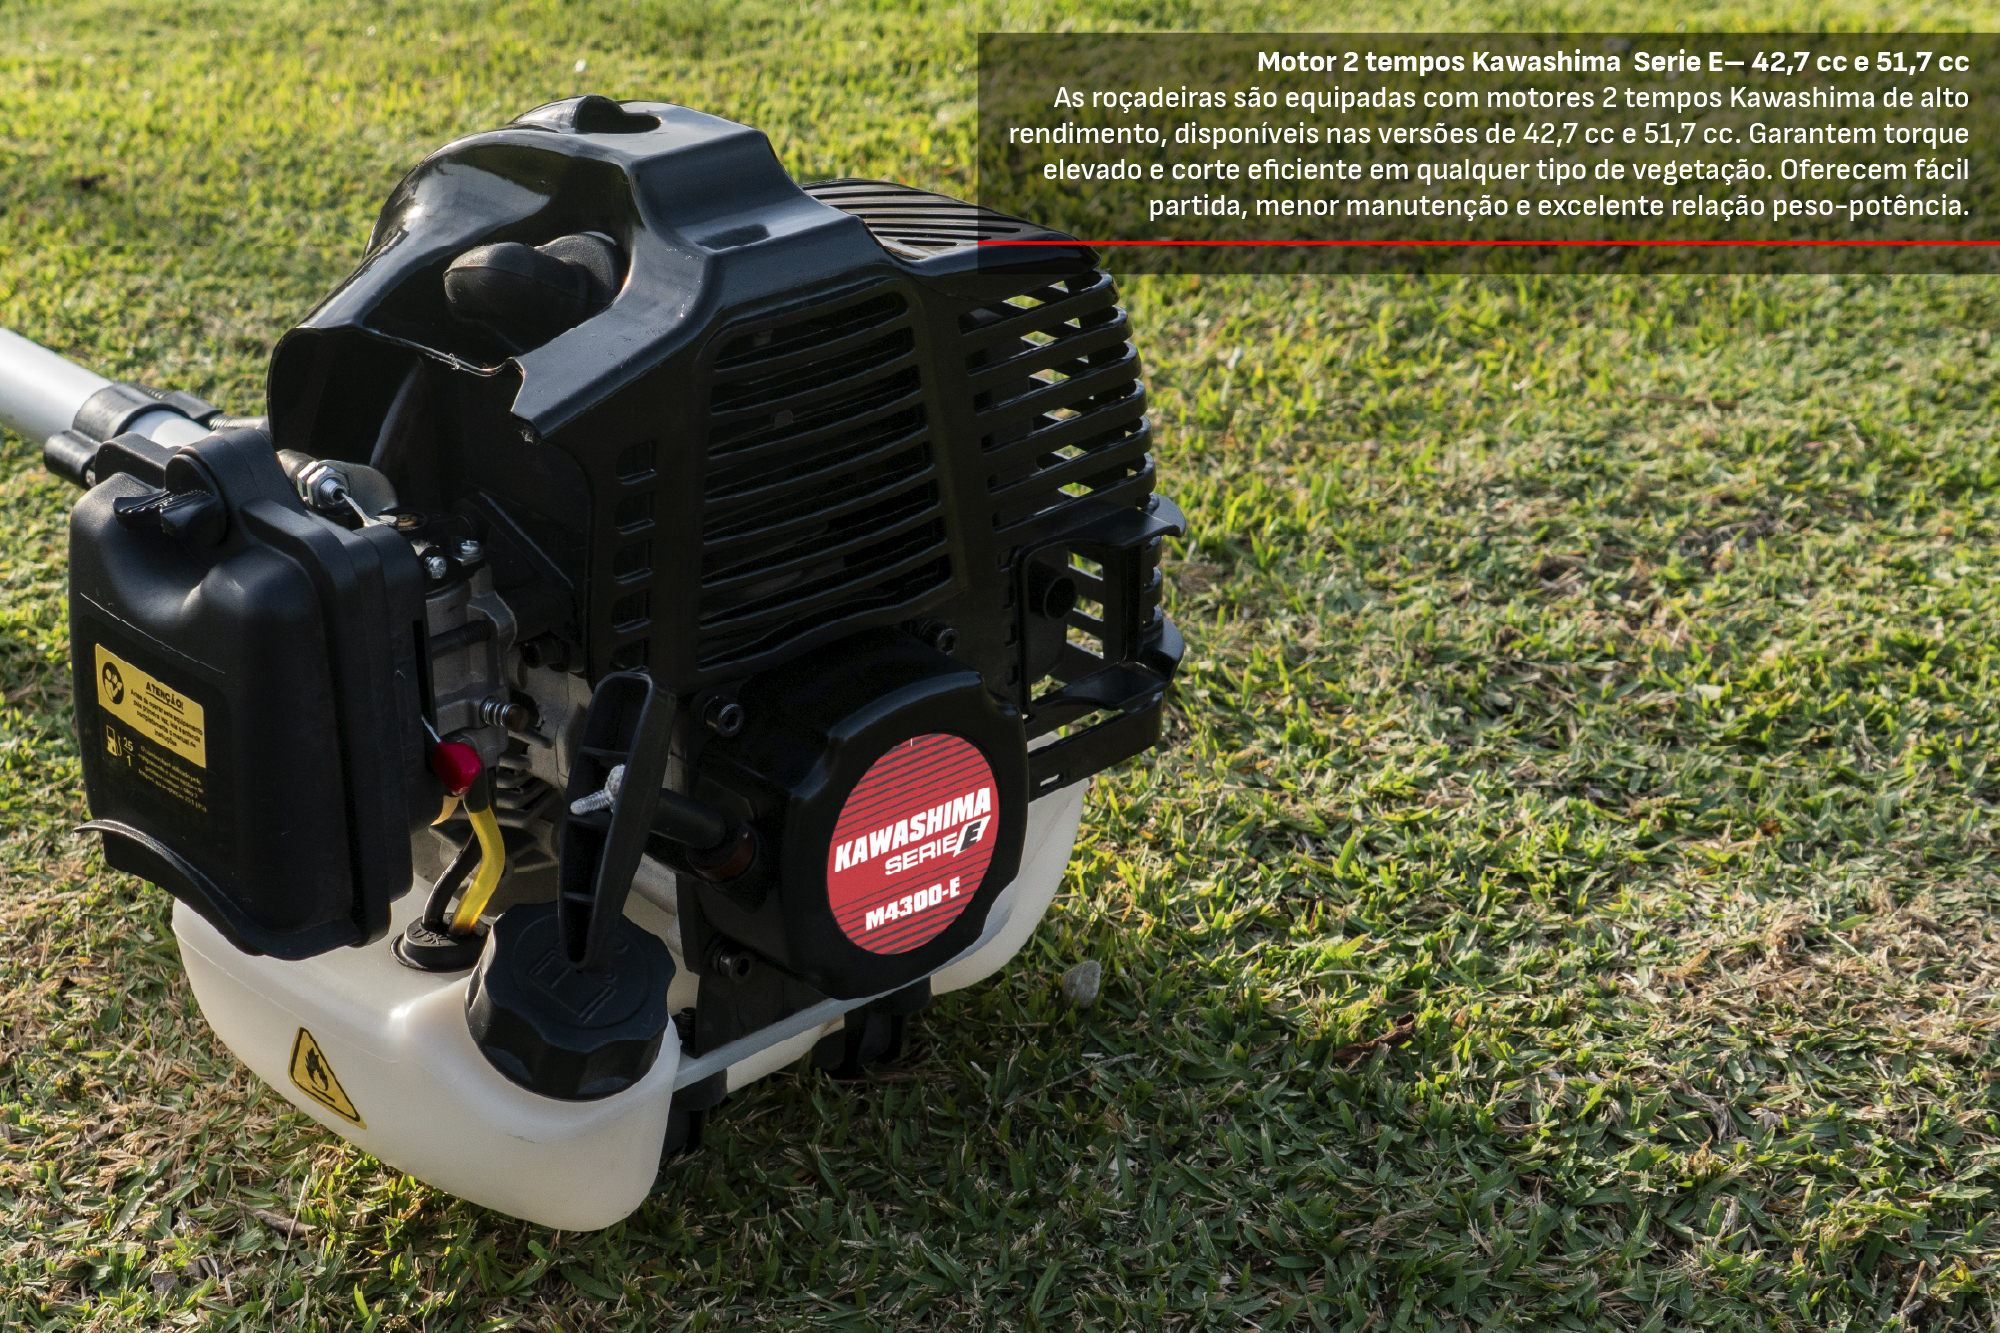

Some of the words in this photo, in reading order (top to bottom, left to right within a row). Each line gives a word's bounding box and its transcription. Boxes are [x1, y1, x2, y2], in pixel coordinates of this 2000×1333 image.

[146, 682, 184, 711] ATENÇÃO!
[124, 737, 134, 752] 25
[126, 755, 132, 767] 1
[834, 787, 991, 873] KAWASHIMA
[885, 832, 958, 875] SERIE
[865, 876, 961, 931] M4300-E
